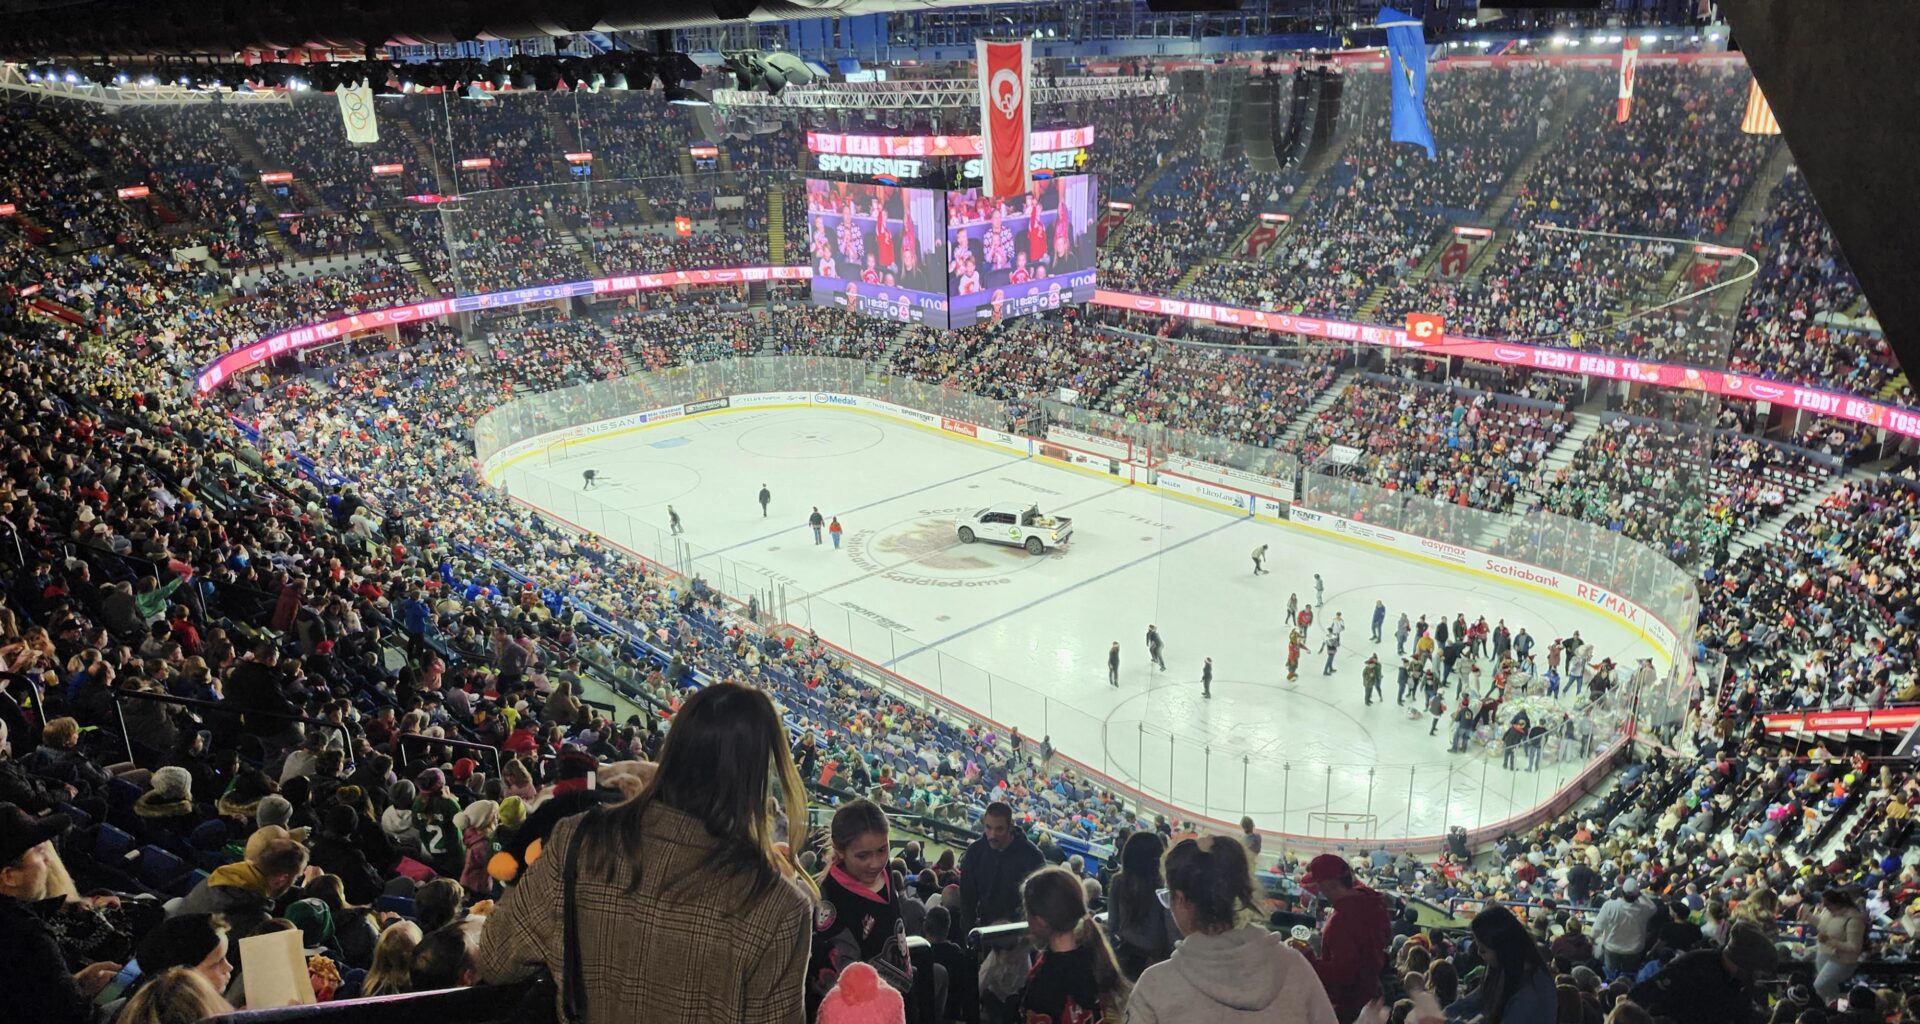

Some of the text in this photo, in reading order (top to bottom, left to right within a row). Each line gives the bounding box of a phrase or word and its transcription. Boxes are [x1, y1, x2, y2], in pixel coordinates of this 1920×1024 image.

[819, 153, 922, 178] SPORTSNET
[889, 305, 898, 316] 0
[1039, 297, 1048, 307] 0
[1325, 322, 1358, 340] TEDDY
[1579, 356, 1615, 376] BEAR
[829, 394, 857, 406] Medals
[1793, 389, 1841, 413] TEDDY
[648, 411, 682, 423] SUPERSTORE
[901, 408, 935, 423] SPORTSNET
[586, 417, 636, 434] NISSAN
[943, 419, 954, 431] Tim
[1421, 538, 1466, 557] easymax
[882, 570, 1011, 588] Saddledome
[1485, 559, 1560, 589] Scotiabank
[1576, 583, 1639, 622] RE/MAX
[426, 823, 447, 854] 2
